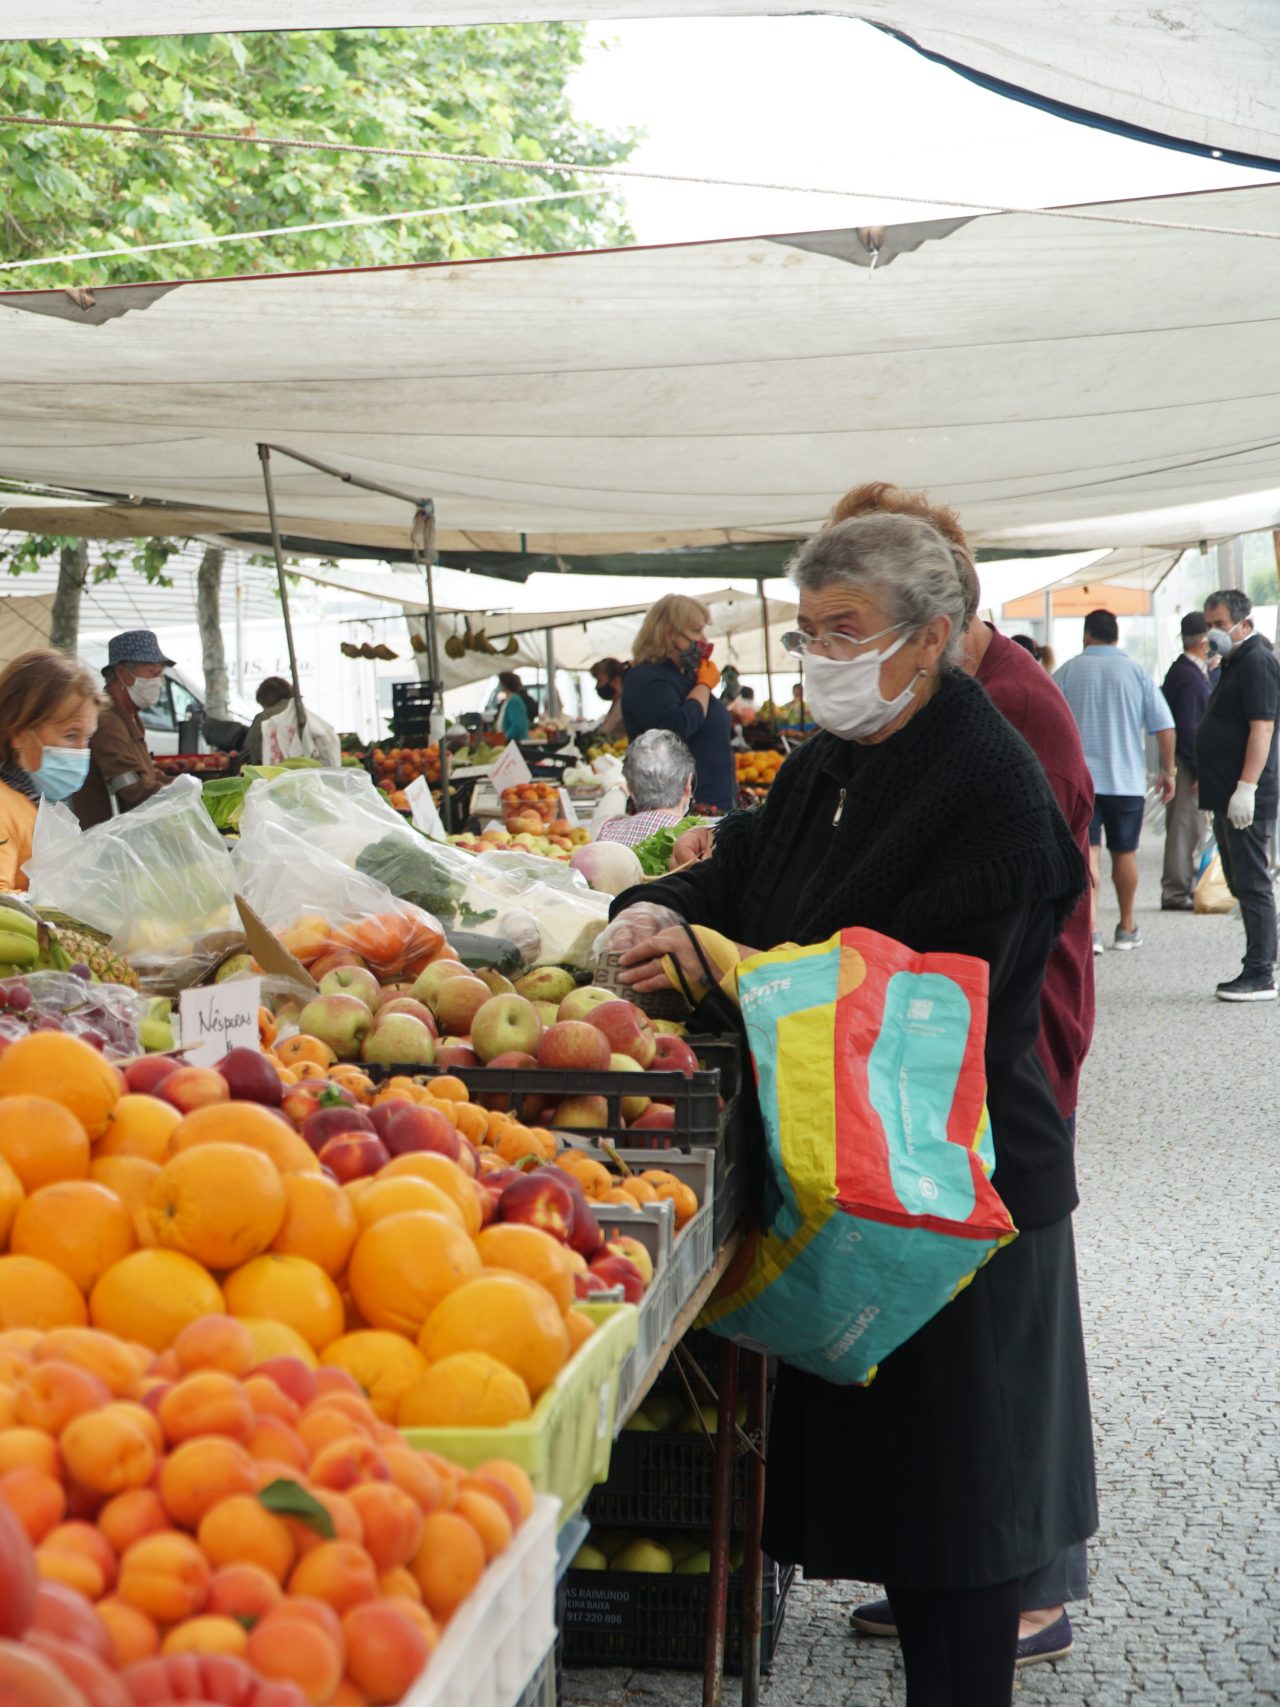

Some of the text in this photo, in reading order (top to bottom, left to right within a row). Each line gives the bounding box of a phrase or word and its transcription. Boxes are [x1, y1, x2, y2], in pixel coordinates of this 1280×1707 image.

[579, 1588, 630, 1602] RAIMUNDO
[586, 1600, 611, 1611] BAIXA
[566, 1610, 583, 1622] 917
[584, 1612, 603, 1624] 220
